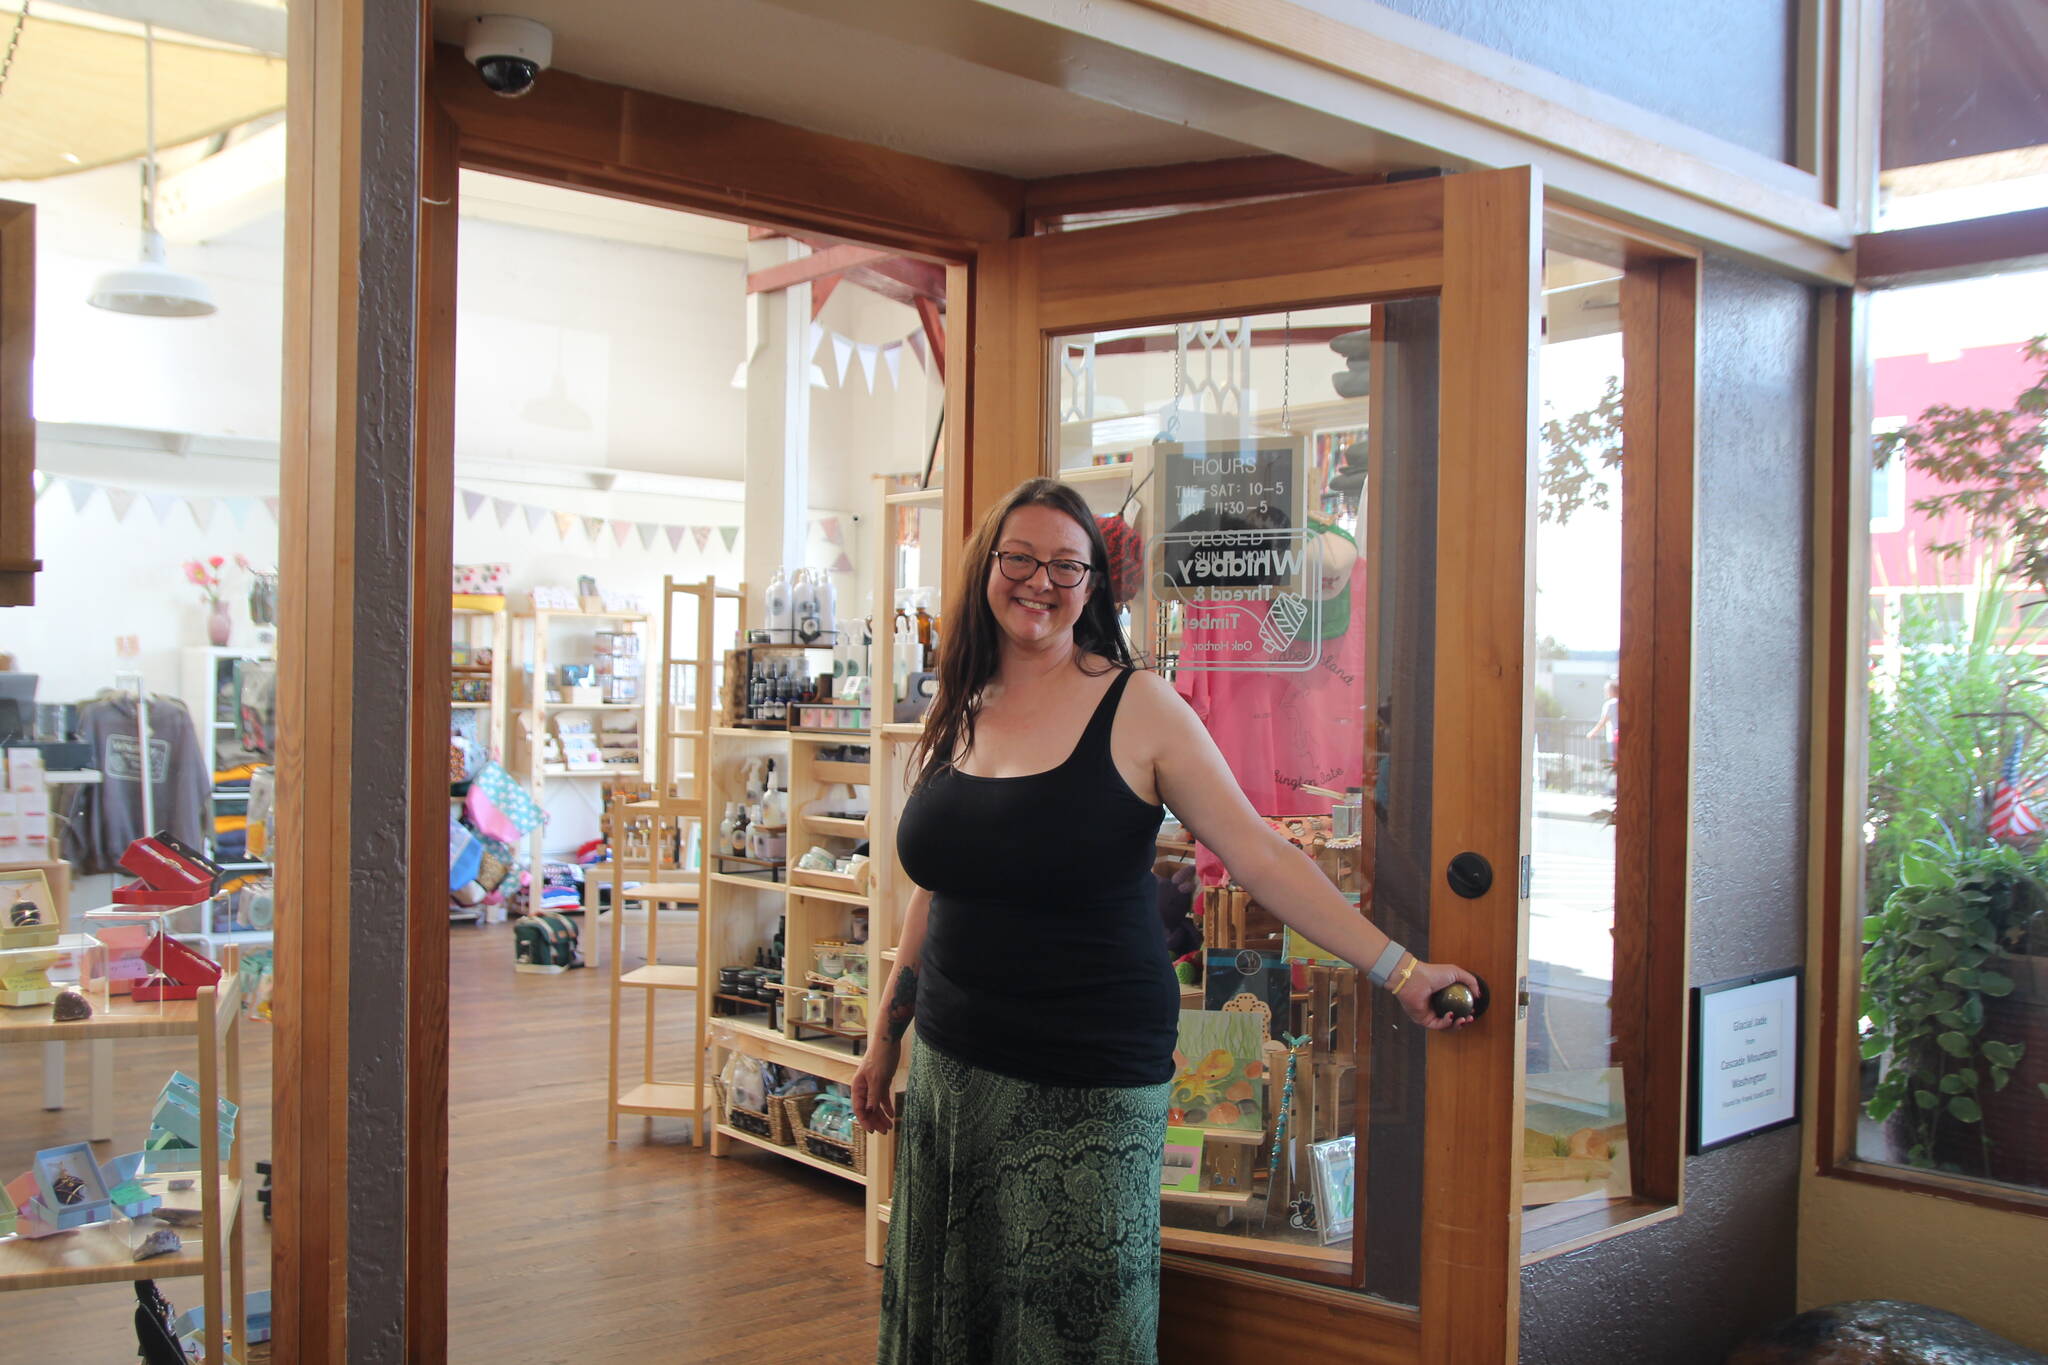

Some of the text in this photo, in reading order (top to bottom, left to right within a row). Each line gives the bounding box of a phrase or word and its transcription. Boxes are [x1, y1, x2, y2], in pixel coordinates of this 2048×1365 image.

[1192, 458, 1257, 476] HOURS
[1188, 530, 1264, 548] CLOSED
[1731, 1072, 1767, 1088] Washington
